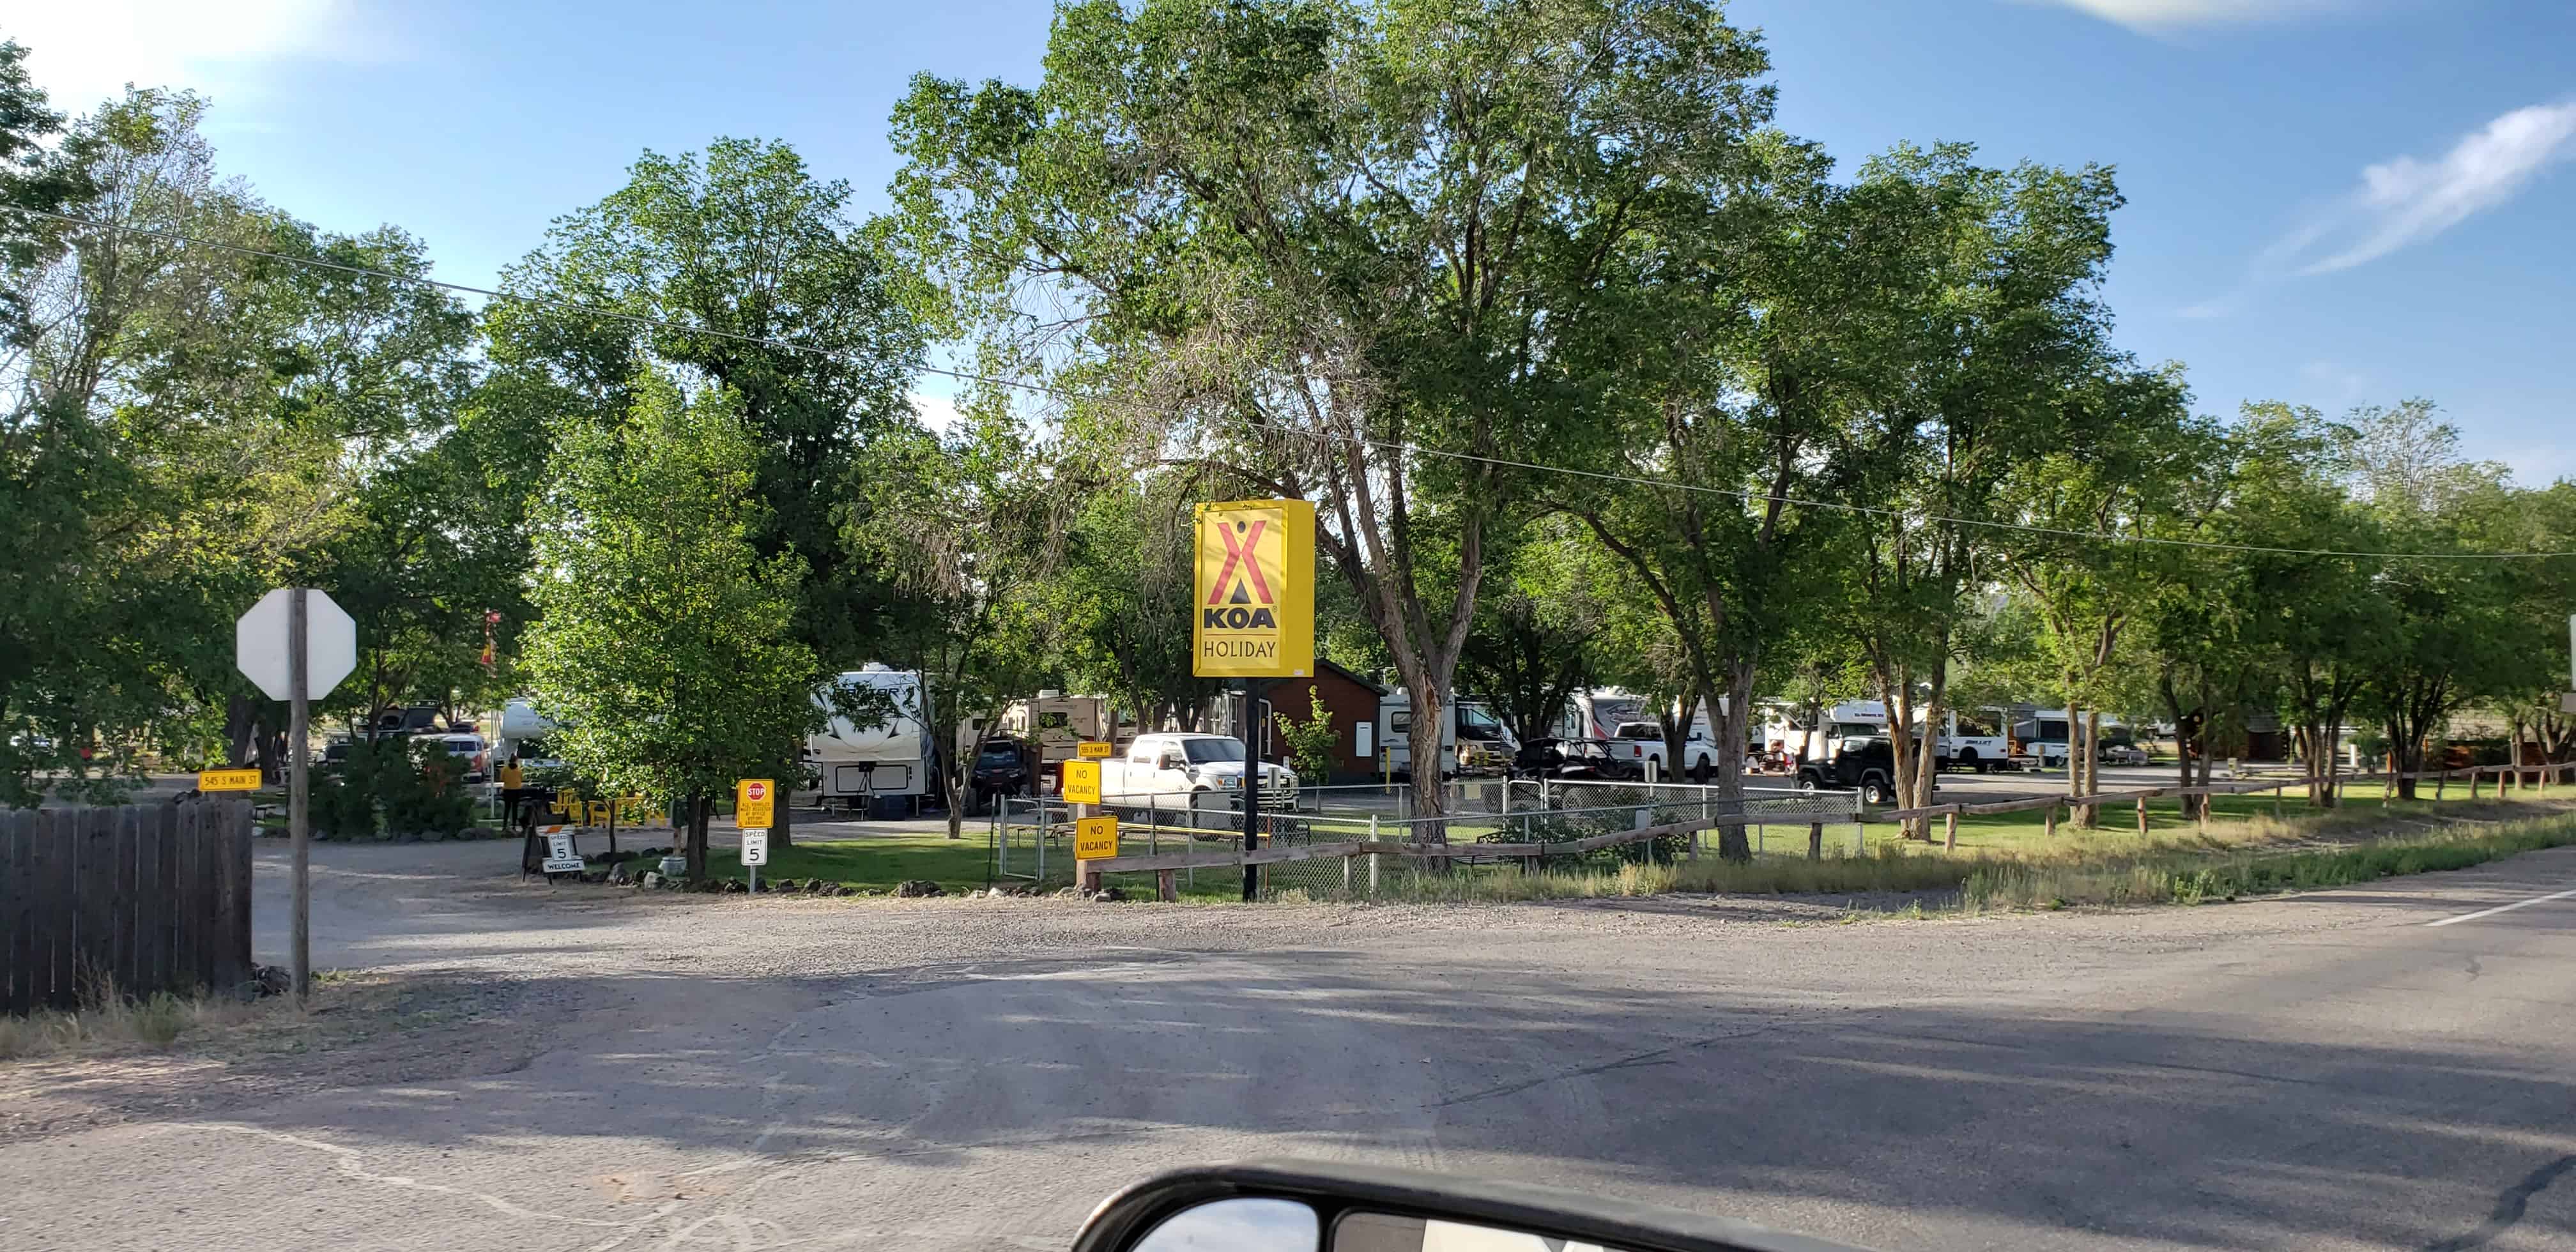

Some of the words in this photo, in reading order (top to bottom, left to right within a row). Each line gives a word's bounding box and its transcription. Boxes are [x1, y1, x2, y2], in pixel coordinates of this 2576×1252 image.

[1204, 607, 1277, 629] KOA
[1204, 641, 1276, 657] HOLIDAY
[221, 776, 226, 784] S
[229, 775, 246, 784] MAIN
[249, 775, 257, 784] ST
[1076, 770, 1087, 779] NO
[1068, 784, 1095, 795] VACANCY
[1090, 825, 1103, 835] NO
[1080, 840, 1113, 851] VACANCY
[557, 848, 566, 859] 5
[749, 848, 760, 860] 5
